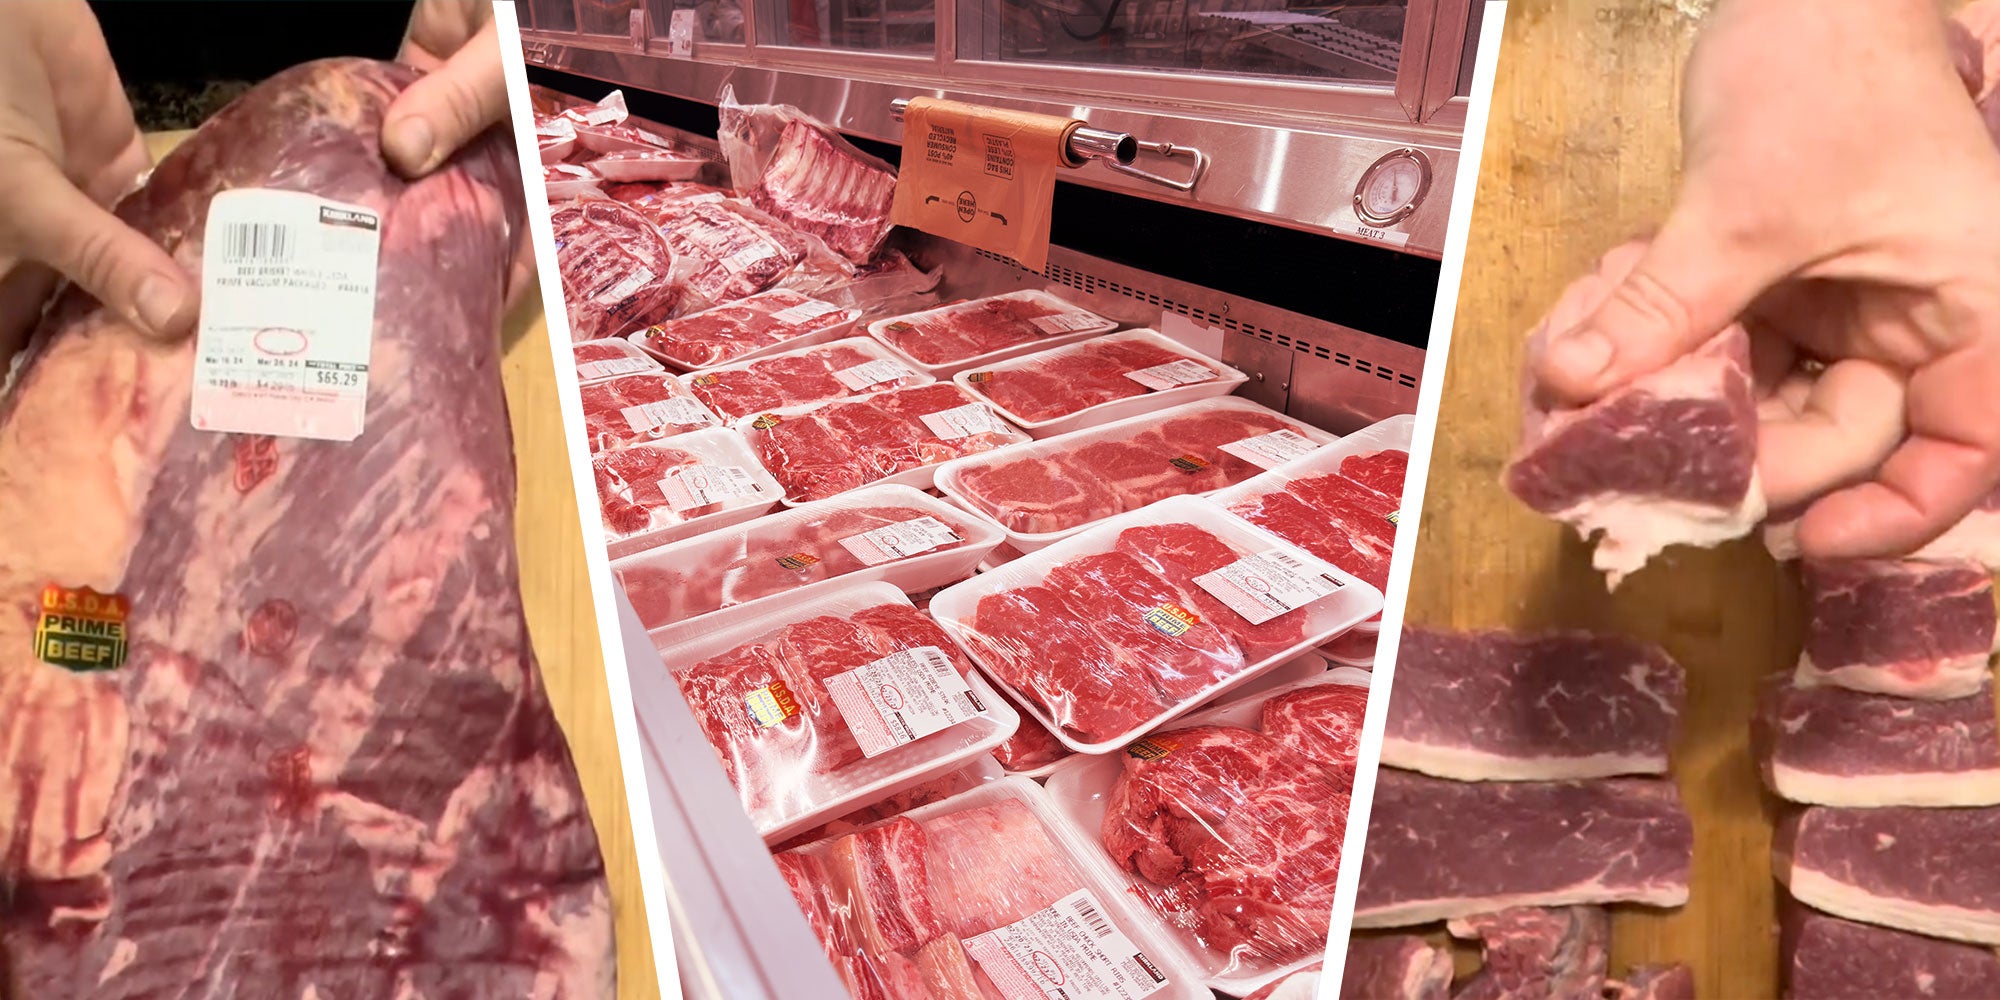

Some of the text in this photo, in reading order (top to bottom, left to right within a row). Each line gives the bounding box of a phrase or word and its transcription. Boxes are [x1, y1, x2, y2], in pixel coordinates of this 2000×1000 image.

[928, 133, 956, 144] RECYCLED
[927, 141, 956, 153] CONSUMER
[928, 150, 941, 158] POST
[986, 154, 1014, 166] CONTAINS
[986, 163, 1012, 176] THIS BAG
[959, 198, 976, 206] HERE
[958, 206, 976, 216] OPEN
[1356, 226, 1386, 240] MEAT 3
[317, 371, 358, 386] $65.29
[1162, 603, 1194, 626] U.S.D.A.
[45, 614, 122, 638] PRIME
[46, 639, 112, 662] BEEF
[771, 682, 795, 716] U.S.D.A.
[1060, 920, 1070, 929] IN
[1067, 929, 1081, 944] USDA
[1080, 944, 1097, 962] PRIME
[1067, 916, 1126, 984] BEEF CHUCK SHORT RIBS
[1138, 954, 1165, 980] KIRKLAND
